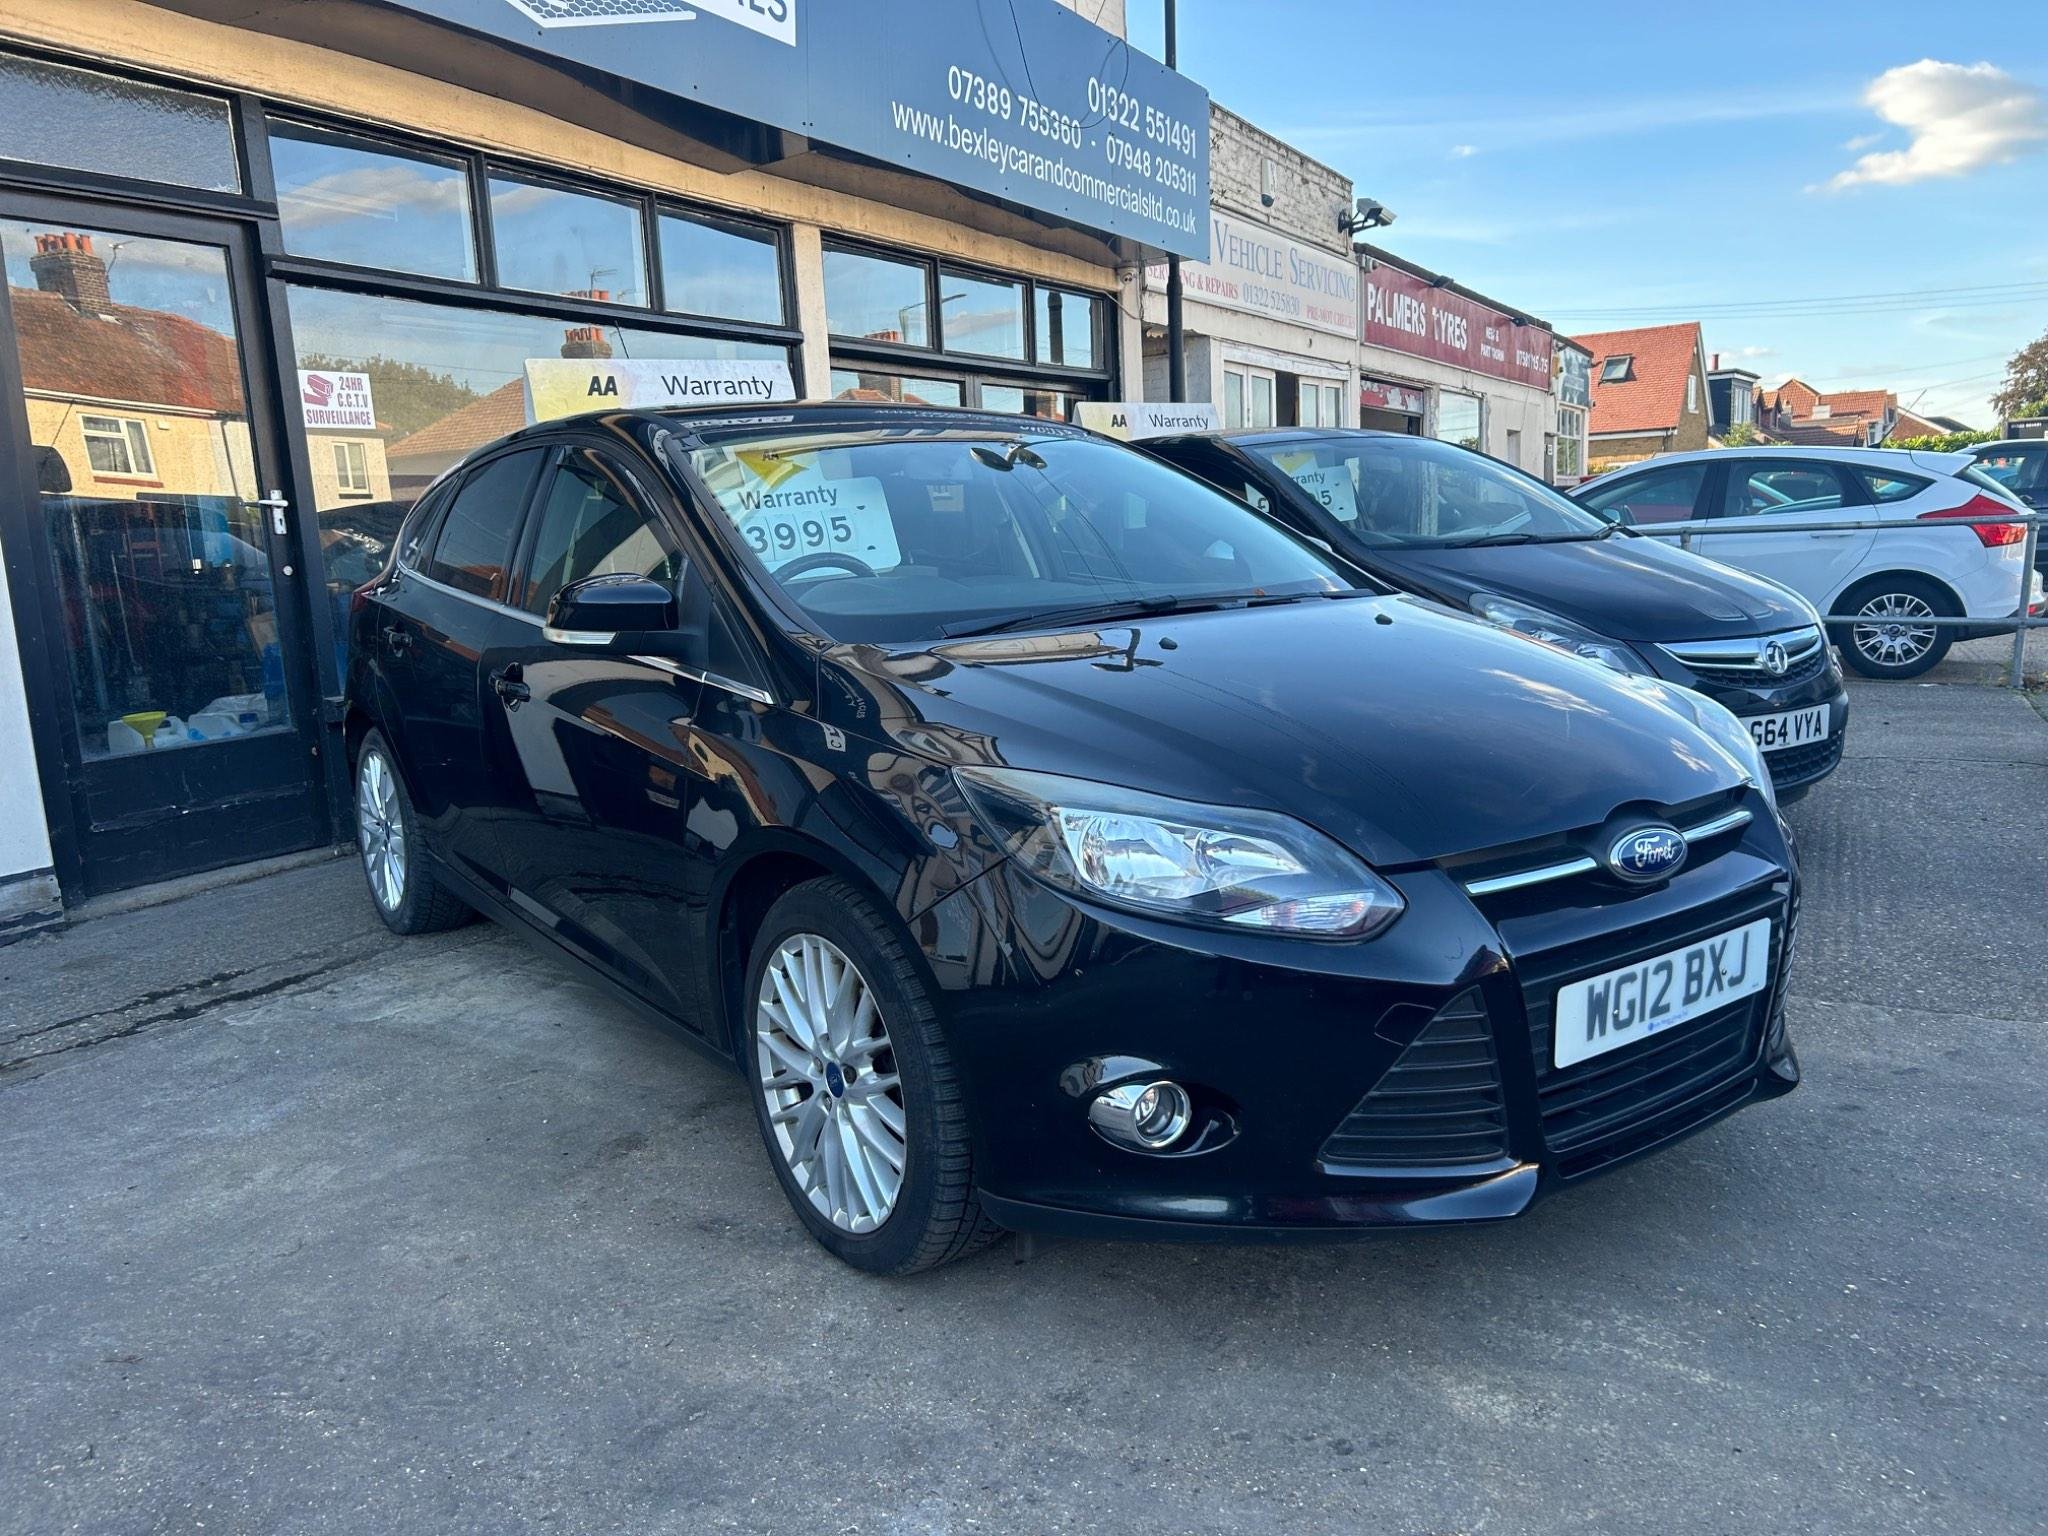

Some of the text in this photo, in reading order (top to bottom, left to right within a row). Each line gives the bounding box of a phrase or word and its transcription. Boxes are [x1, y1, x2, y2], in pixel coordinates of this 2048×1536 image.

[948, 65, 1197, 197] 07389 755360 07948 205311
[1088, 76, 1197, 159] 01322 551491
[892, 101, 1197, 235] www.bexleycarandcommercialsltd.co.uk
[1213, 219, 1355, 302] VEHICLE SERVICING
[1205, 276, 1239, 300] REPAIRS
[1367, 283, 1426, 337] PALMERS
[338, 376, 364, 391] 24HR
[587, 375, 618, 396] AA
[661, 375, 774, 400] Warranty
[337, 393, 369, 408] C.C.T.V
[305, 409, 372, 425] SURVEILLANCE
[1111, 414, 1128, 428] AA
[1148, 414, 1209, 431] Warranty
[737, 485, 838, 511] Warranty
[745, 515, 852, 554] 3995
[1750, 710, 1822, 747] G64 VYA
[1634, 835, 1678, 868] Ford
[1586, 930, 1749, 1042] WG12 BXJ
